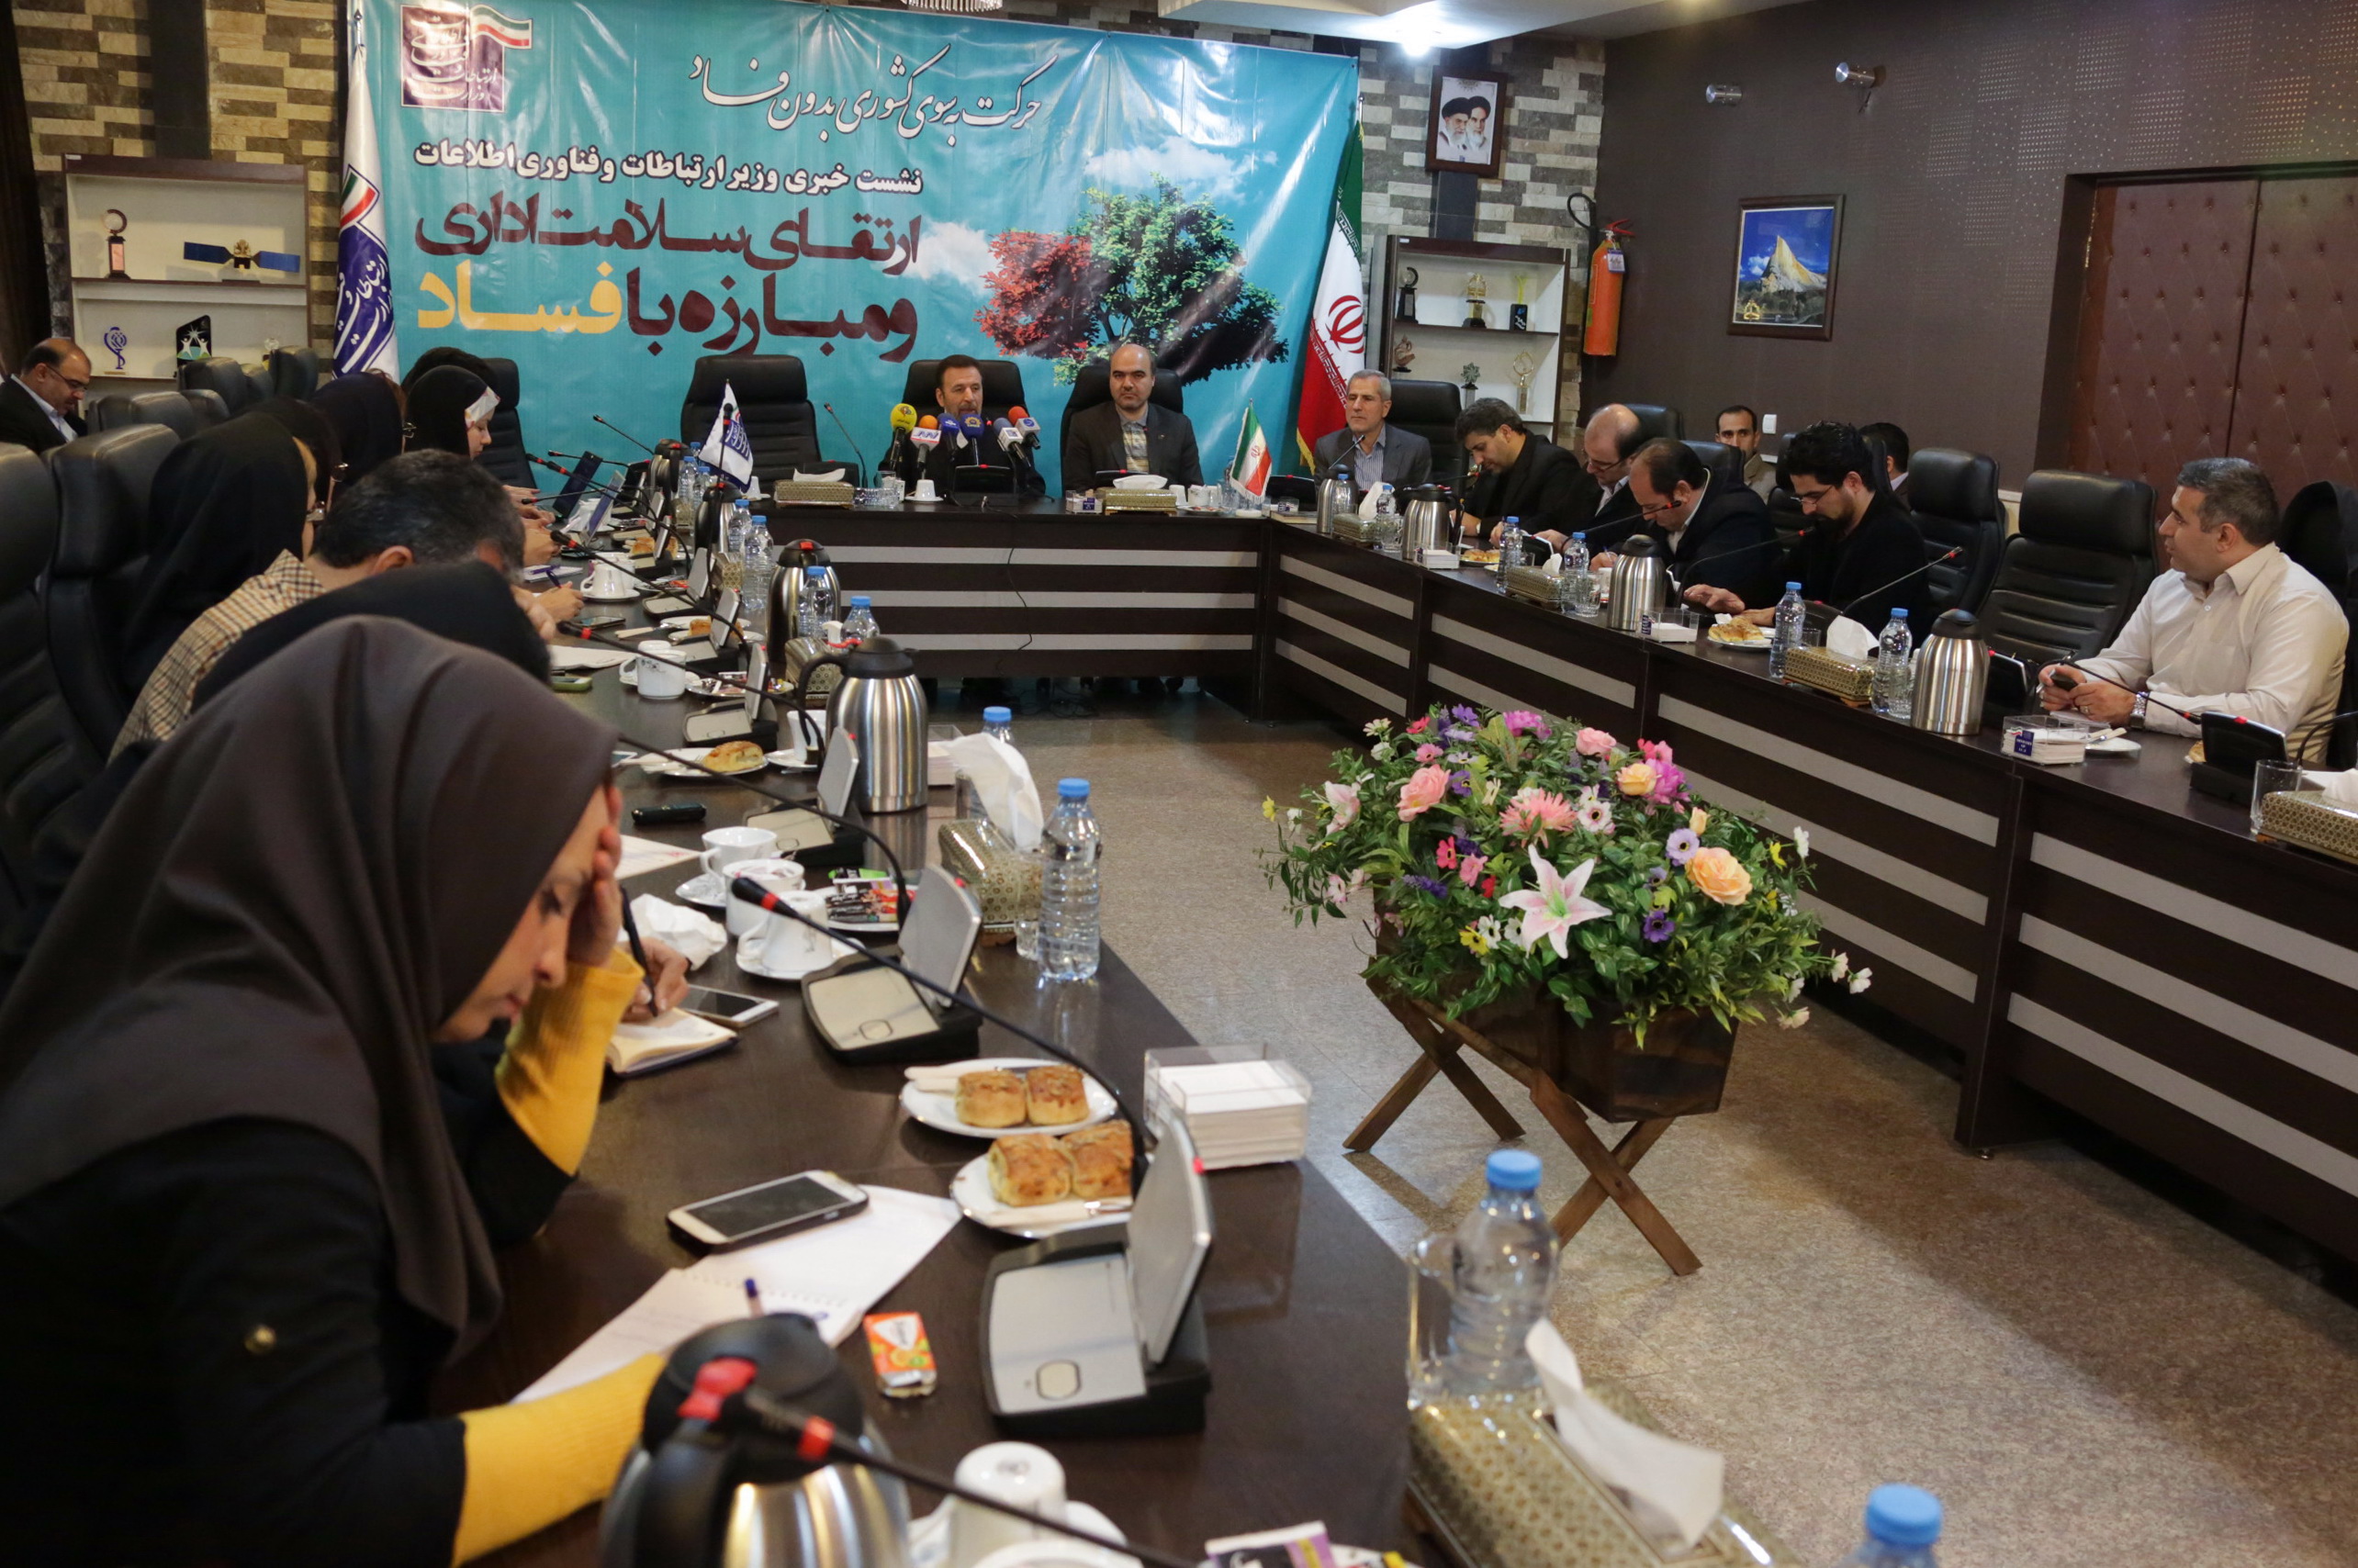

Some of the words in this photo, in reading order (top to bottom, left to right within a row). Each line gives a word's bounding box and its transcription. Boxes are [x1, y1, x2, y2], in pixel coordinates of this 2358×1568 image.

[766, 91, 837, 142] بدون
[834, 43, 951, 134] کشوری
[961, 54, 1060, 129] حرکت
[413, 138, 516, 169] اطلاعات
[621, 150, 726, 190] ارتباطات
[725, 162, 779, 193] وزیر
[783, 162, 851, 196] خبری
[855, 168, 924, 195] نشست
[415, 190, 540, 256] اداری
[539, 197, 747, 253] سلامت
[743, 207, 922, 275] ارتقای
[418, 259, 623, 334] فساد
[626, 266, 676, 356] با
